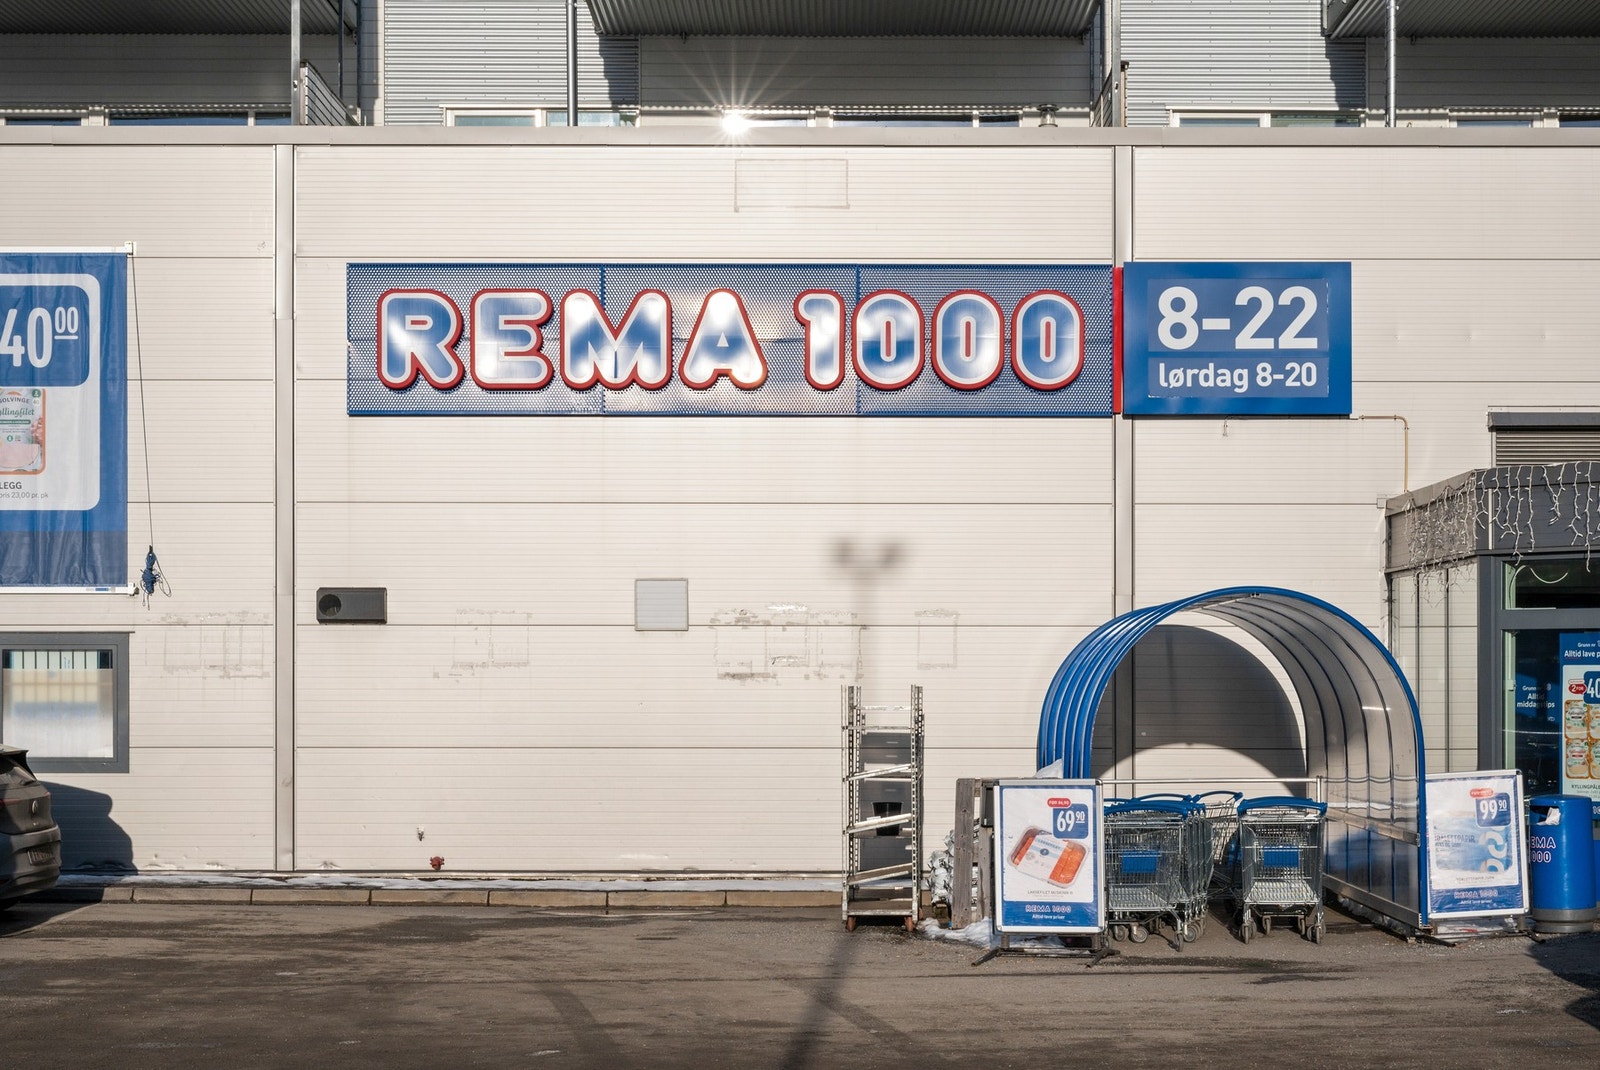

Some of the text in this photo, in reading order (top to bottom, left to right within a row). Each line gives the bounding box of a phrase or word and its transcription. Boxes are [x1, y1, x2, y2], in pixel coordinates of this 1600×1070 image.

[1157, 286, 1318, 350] 8-22
[377, 288, 1084, 390] REMA 1000
[1159, 362, 1317, 393] lørdag 8-20
[0, 481, 22, 490] LEGG
[1564, 650, 1581, 658] Alltid
[1582, 650, 1596, 658] lave
[1480, 800, 1497, 819] 99
[1056, 810, 1085, 832] 69 90
[1025, 904, 1051, 913] REMA
